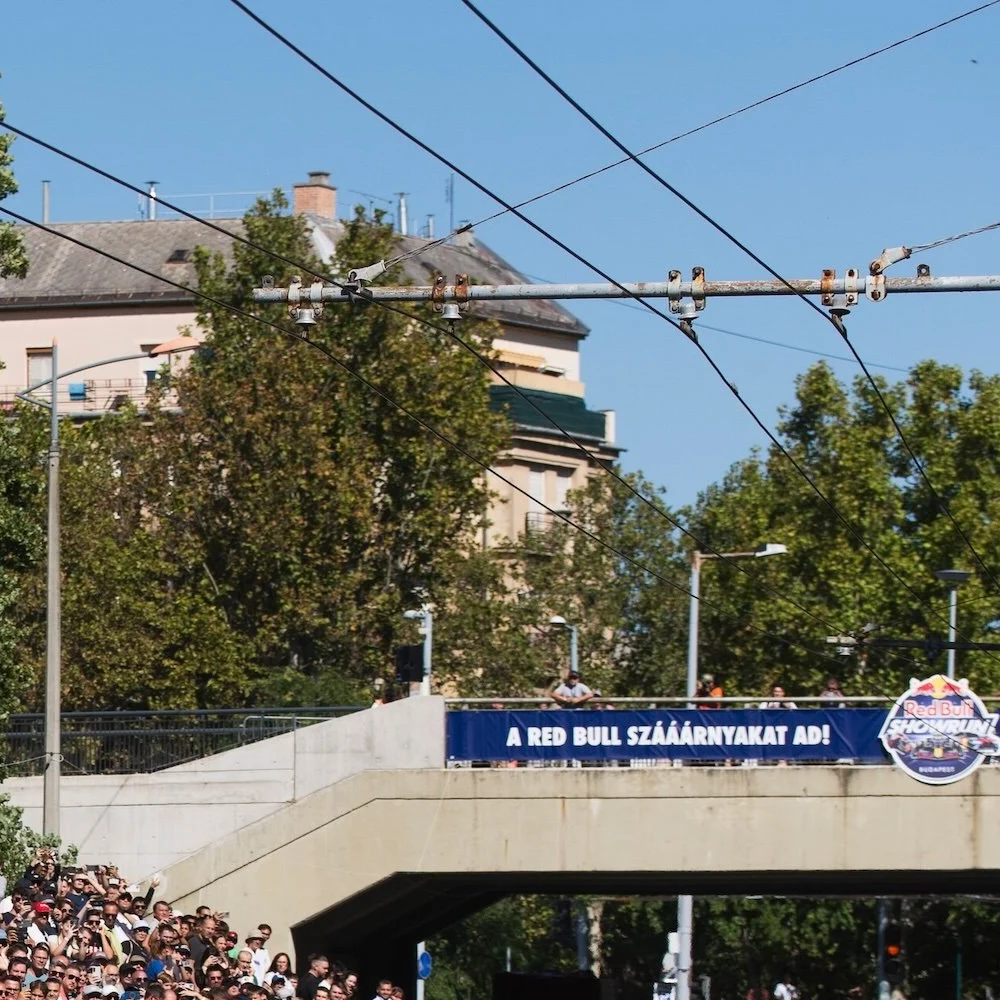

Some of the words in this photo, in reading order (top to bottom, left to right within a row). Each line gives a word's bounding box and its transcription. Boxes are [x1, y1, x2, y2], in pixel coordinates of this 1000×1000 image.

[906, 701, 937, 716] Red
[941, 701, 974, 716] Bull
[506, 726, 521, 746] A
[527, 726, 567, 746] RED
[573, 726, 621, 746] BULL
[627, 720, 788, 746] SZÁÁÁRNYAKAT
[793, 724, 830, 746] AD!
